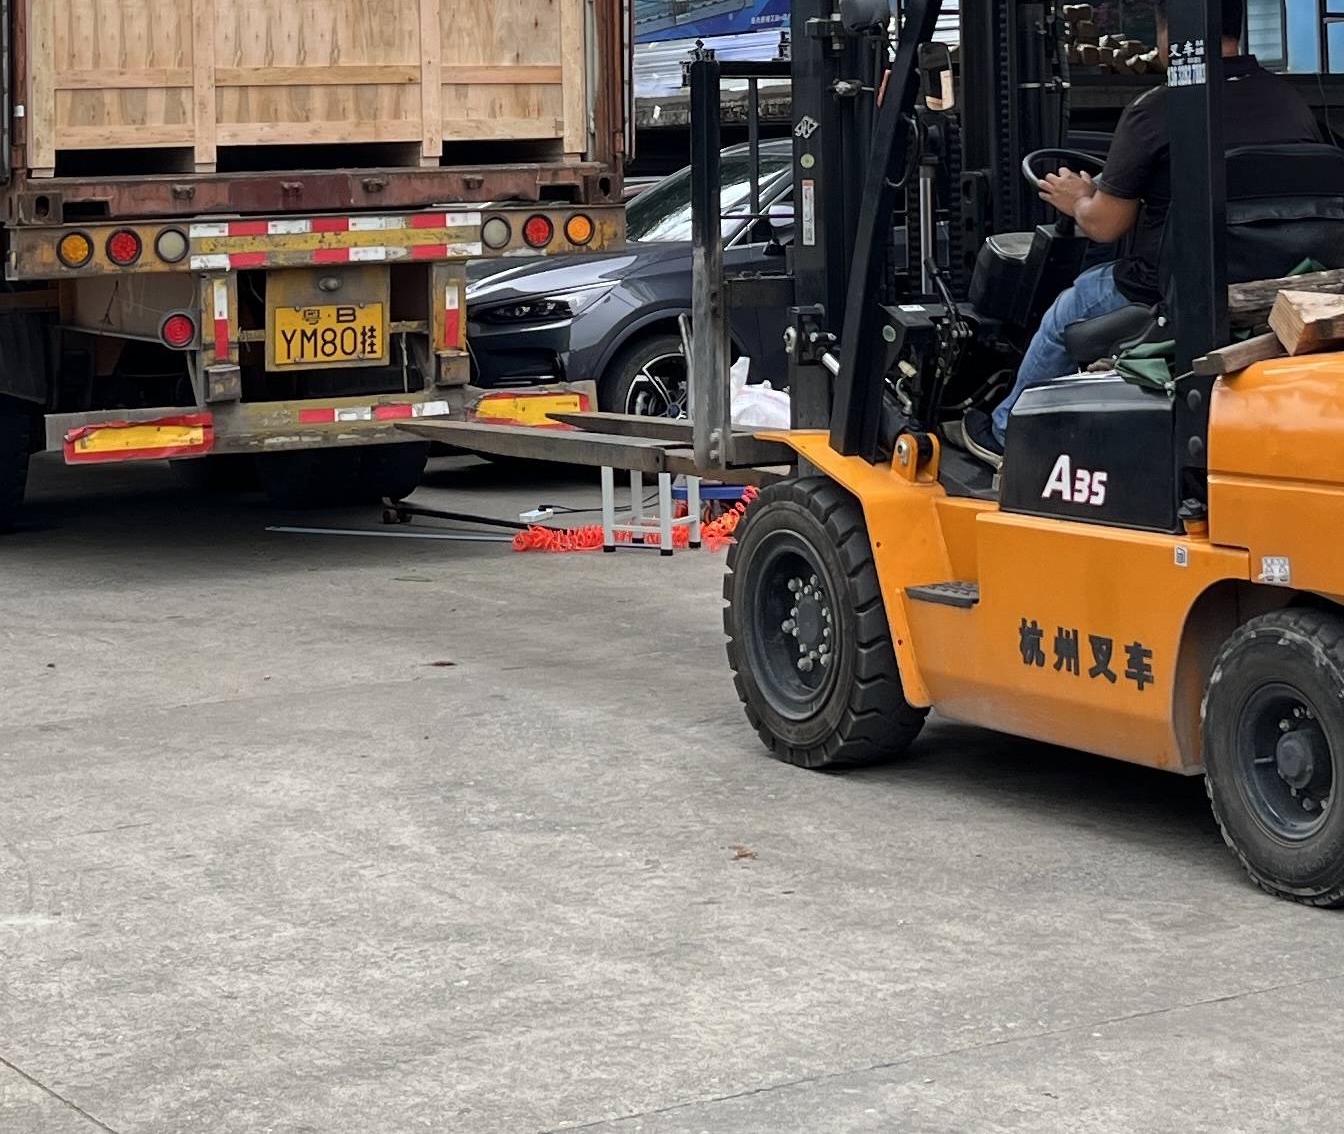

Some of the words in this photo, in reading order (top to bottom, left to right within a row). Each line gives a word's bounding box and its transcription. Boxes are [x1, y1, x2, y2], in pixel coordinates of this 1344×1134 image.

[281, 326, 377, 359] YM80挂
[1041, 454, 1108, 507] A35
[1019, 617, 1155, 691] 杭州叉车
